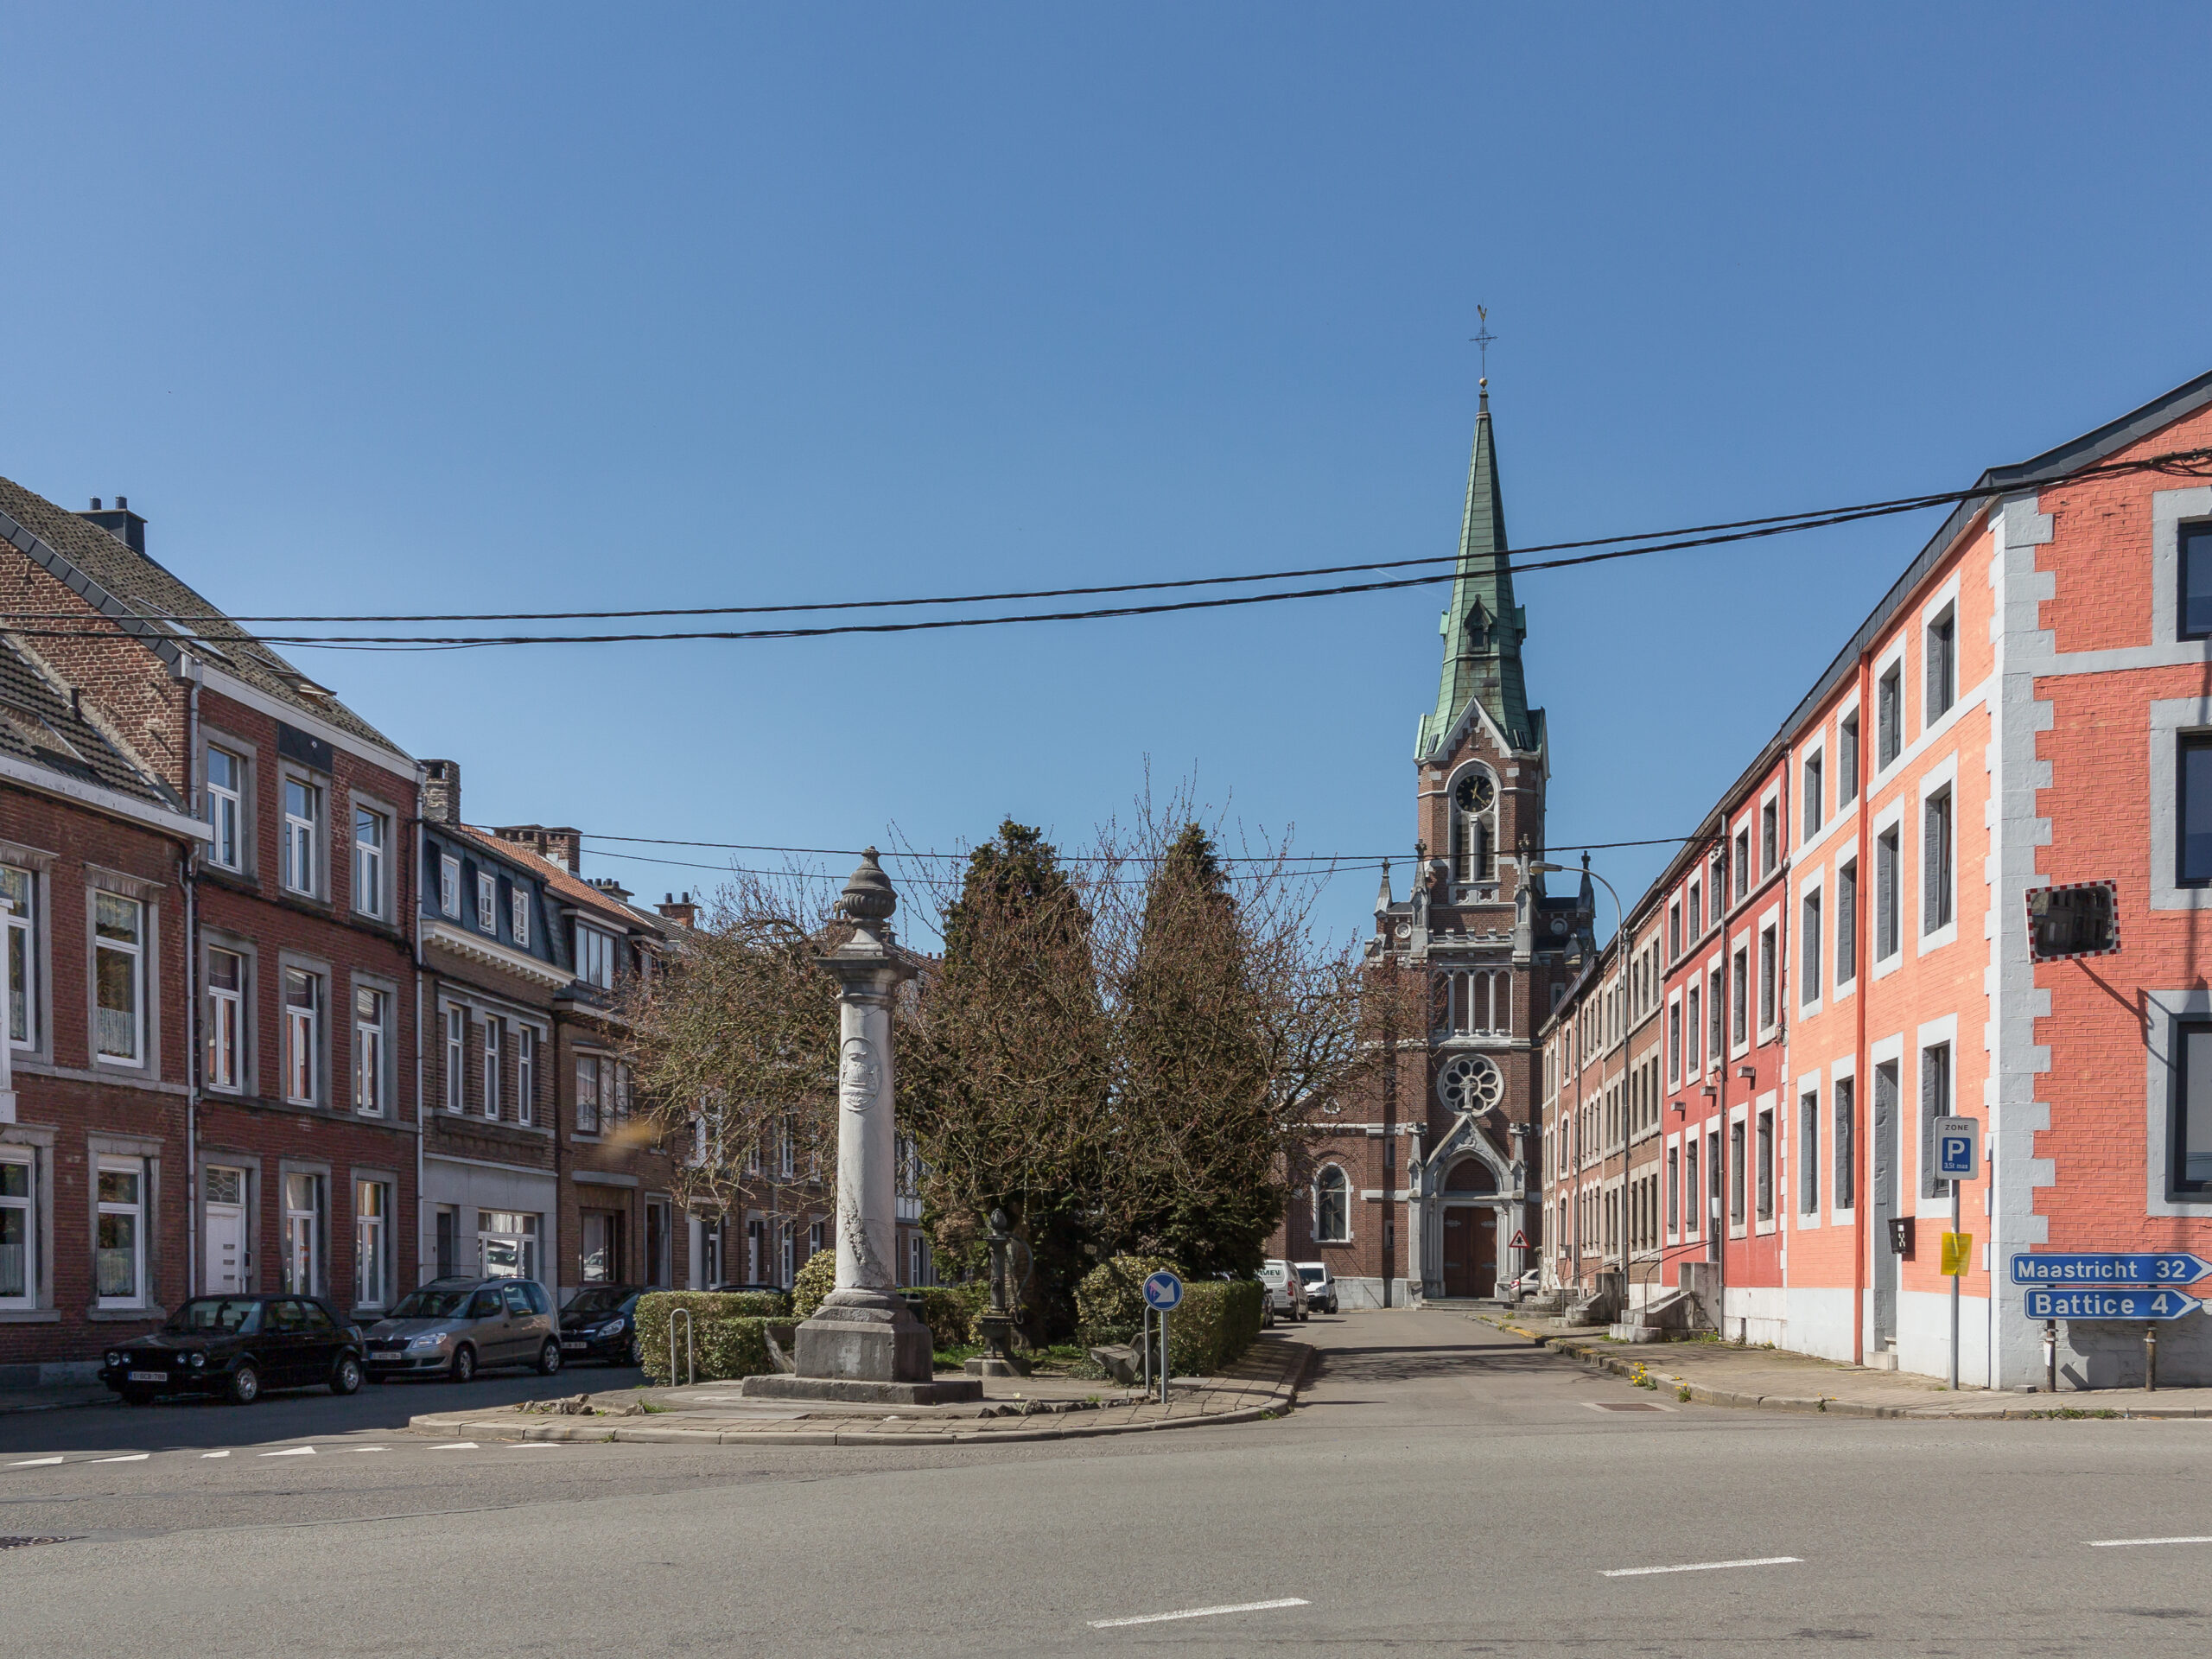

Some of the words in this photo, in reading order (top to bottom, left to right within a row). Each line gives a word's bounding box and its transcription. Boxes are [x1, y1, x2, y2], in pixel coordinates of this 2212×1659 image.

[1948, 1140, 1965, 1161] P
[2018, 1260, 2138, 1279] Maastricht
[2156, 1260, 2186, 1279] 32
[2035, 1294, 2135, 1314] Battice
[2151, 1294, 2169, 1314] 4
